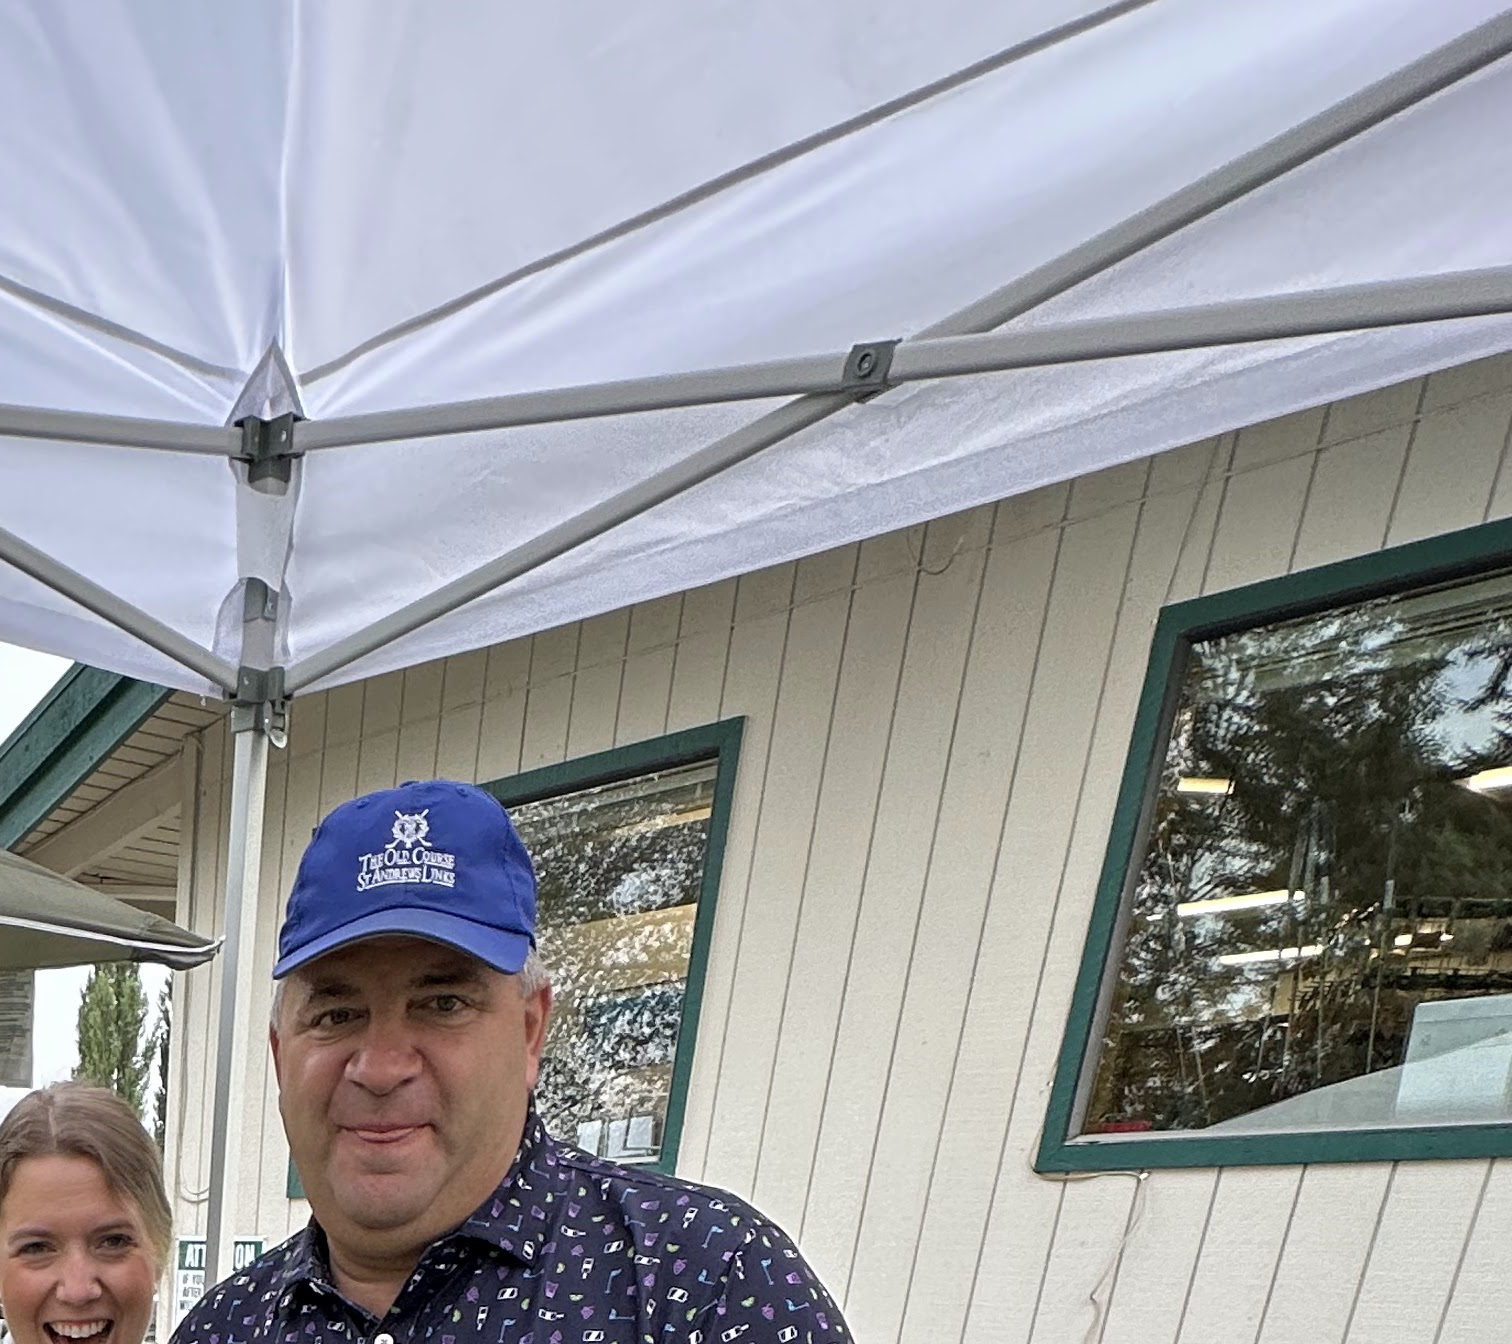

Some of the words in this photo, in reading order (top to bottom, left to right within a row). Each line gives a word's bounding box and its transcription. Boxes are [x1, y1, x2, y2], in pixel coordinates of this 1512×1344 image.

[384, 848, 411, 866] OLD
[412, 846, 455, 869] COURSE
[421, 864, 456, 887] LINKS
